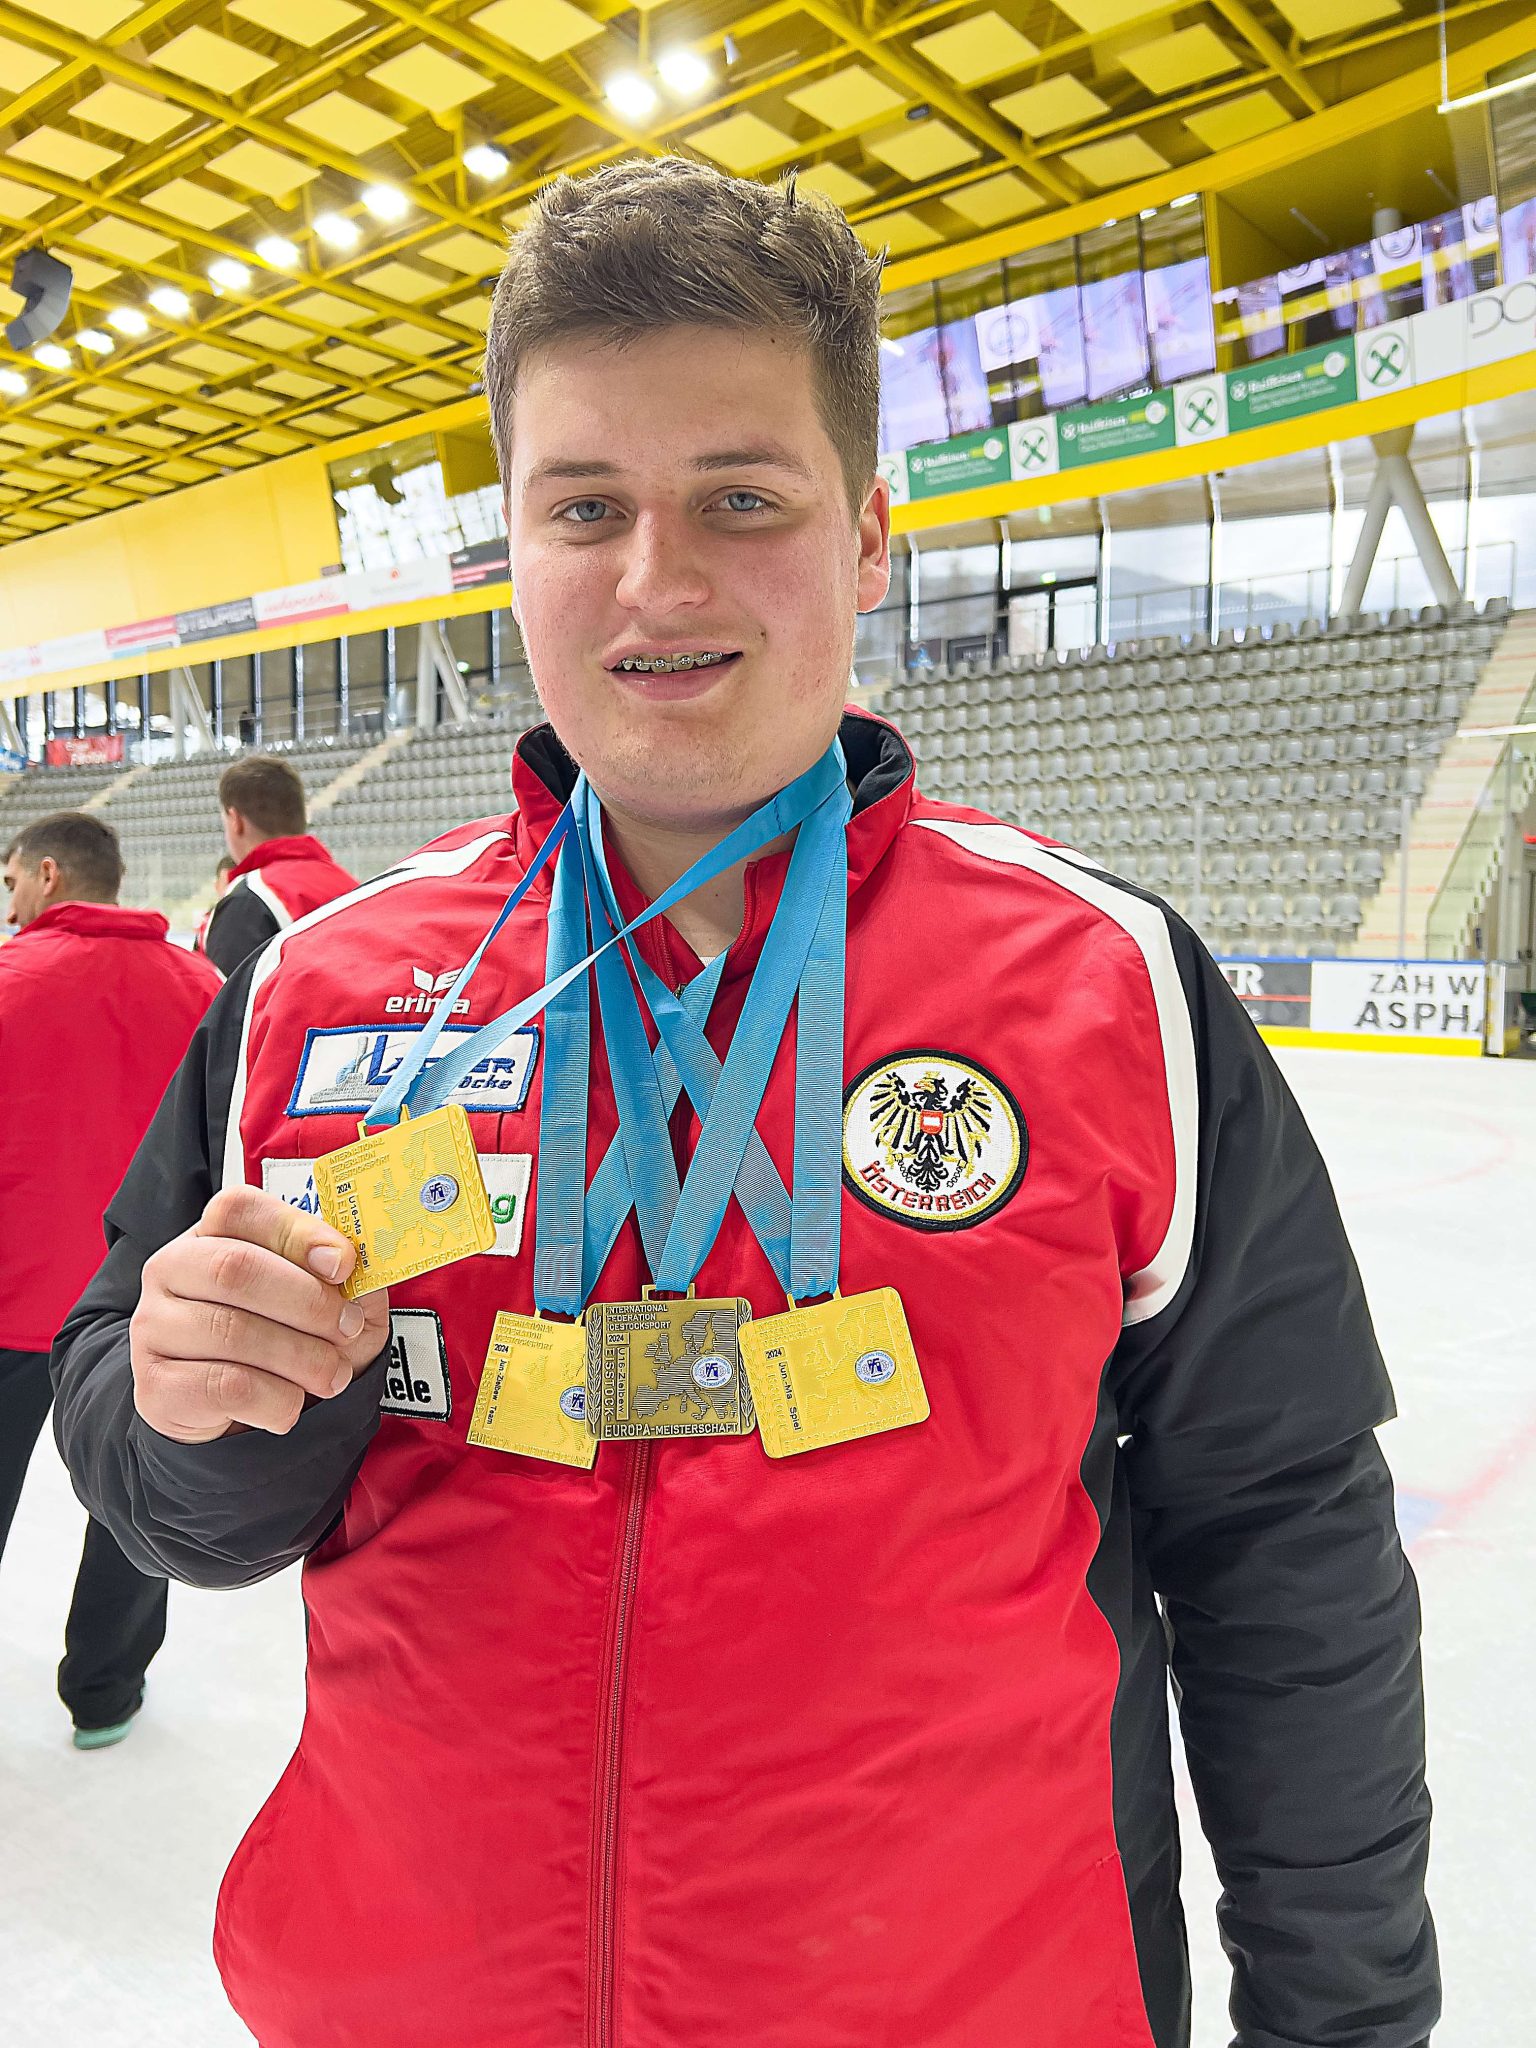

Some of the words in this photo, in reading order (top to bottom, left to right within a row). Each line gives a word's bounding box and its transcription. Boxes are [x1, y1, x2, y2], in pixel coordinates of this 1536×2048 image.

[1354, 1001, 1484, 1033] ASPH
[336, 1182, 352, 1195] 2024
[859, 1160, 997, 1211] ÖSTERREICH
[358, 1242, 370, 1268] Spiel
[607, 1304, 668, 1313] INTERNATIONAL
[607, 1313, 656, 1322] FEDERATION
[607, 1321, 671, 1331] ICESTOCKSPORT
[608, 1334, 624, 1343] 2024
[494, 1343, 509, 1354] 2024
[765, 1349, 783, 1359] 2024
[486, 1405, 497, 1425] Team
[789, 1406, 802, 1431] Spiel
[604, 1422, 738, 1438] EUROPA-MEISTERSCHAFT
